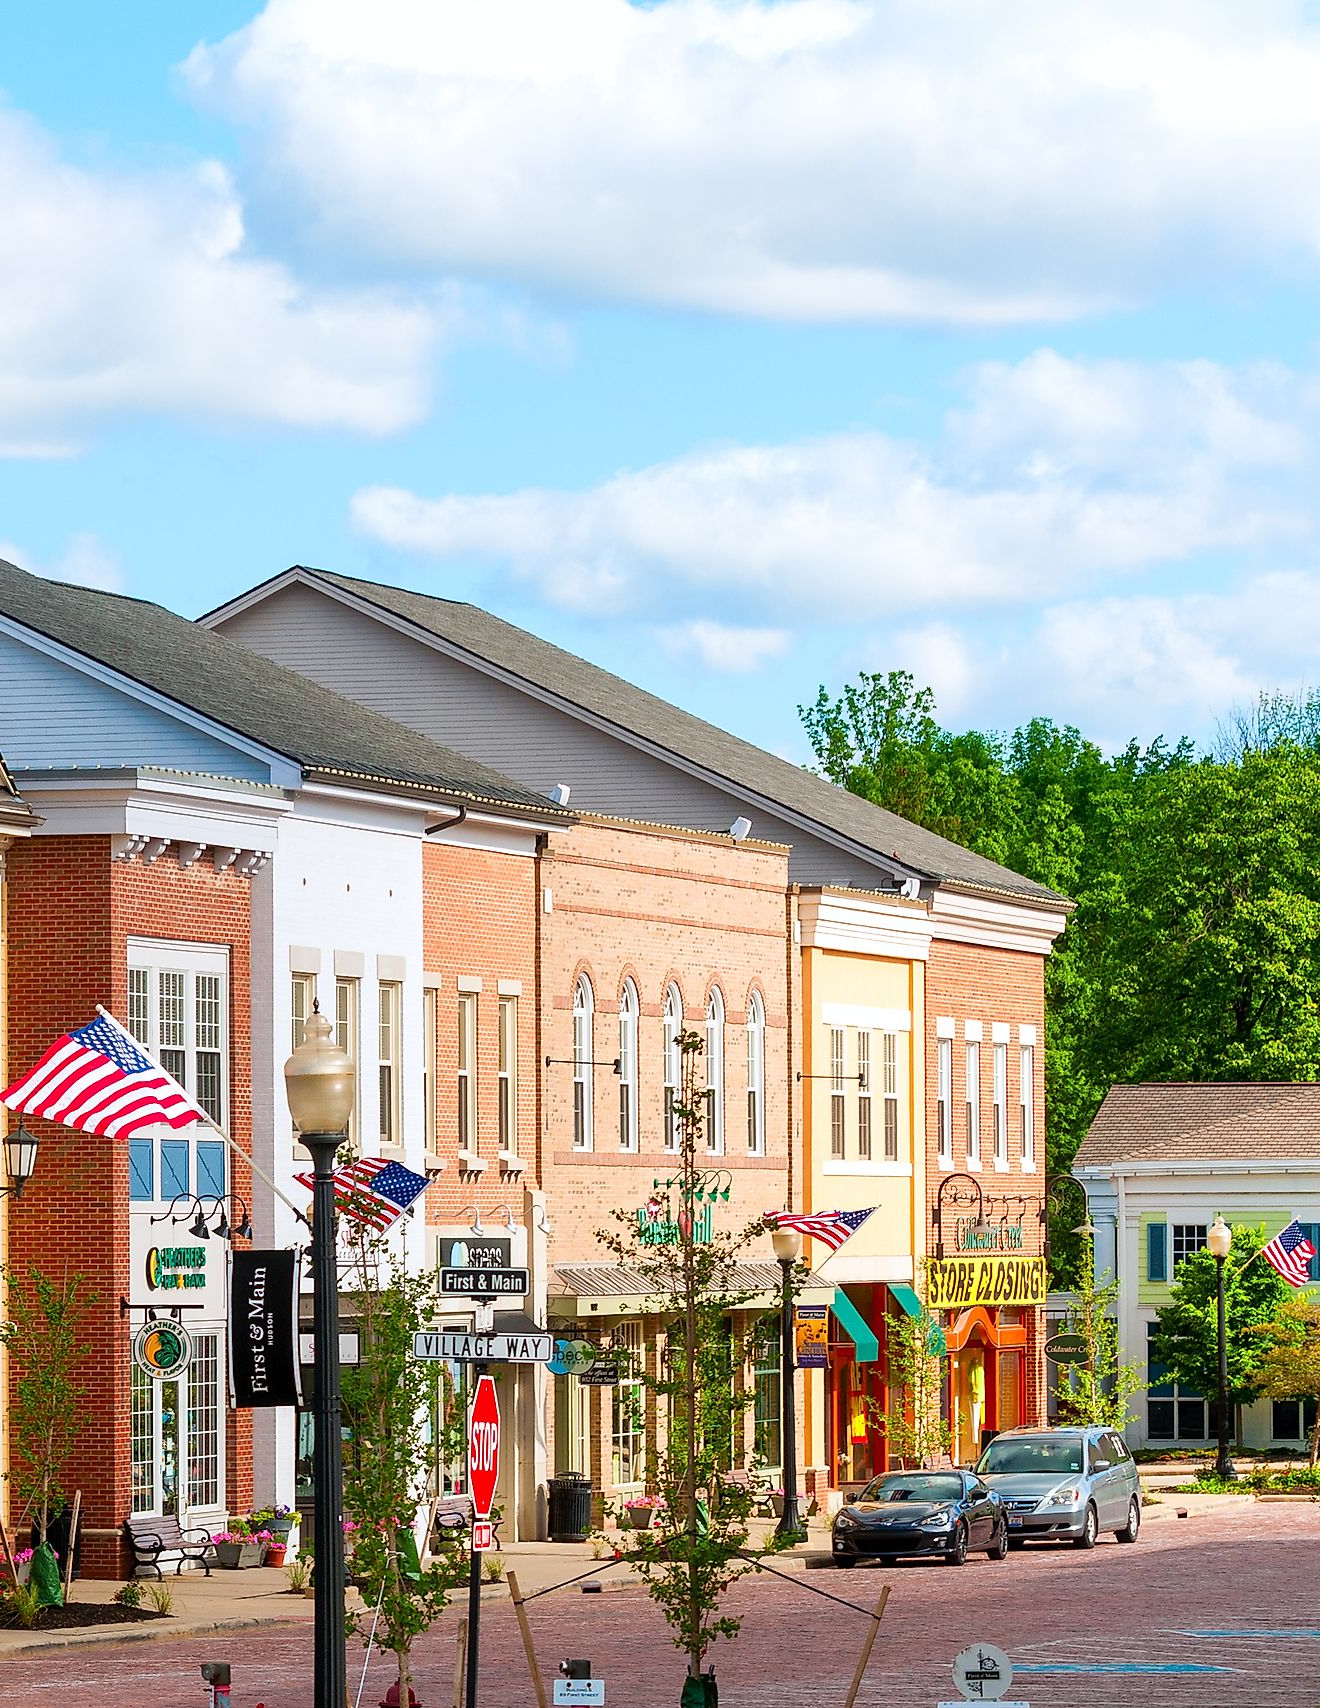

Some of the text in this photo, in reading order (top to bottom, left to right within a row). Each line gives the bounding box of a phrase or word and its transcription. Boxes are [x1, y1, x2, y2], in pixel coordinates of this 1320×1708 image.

[446, 1274, 523, 1291] First & Main
[930, 1260, 1044, 1303] STORE CLOSING!
[143, 1321, 183, 1336] HEATHER'S
[248, 1266, 269, 1393] First & Main
[423, 1335, 542, 1358] VILLAGE WAY
[1045, 1345, 1078, 1353] Coldwater
[471, 1421, 498, 1471] STOP
